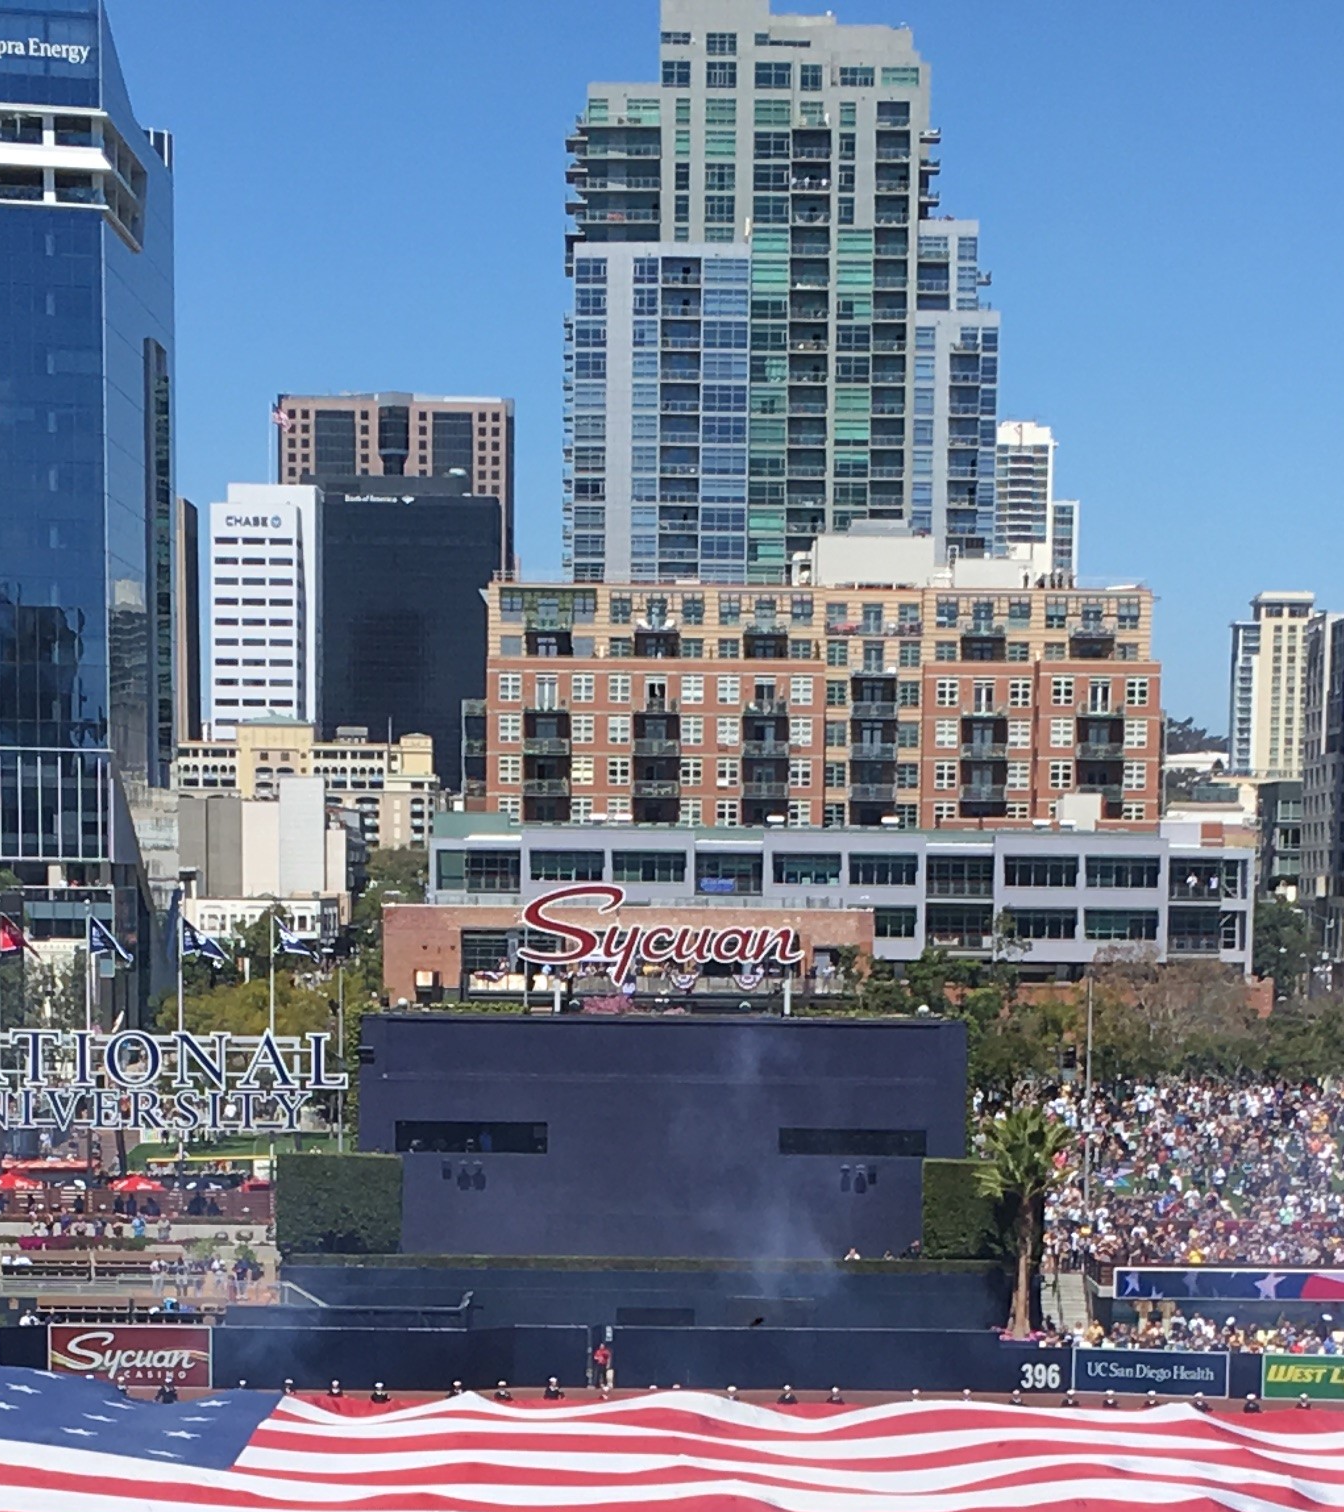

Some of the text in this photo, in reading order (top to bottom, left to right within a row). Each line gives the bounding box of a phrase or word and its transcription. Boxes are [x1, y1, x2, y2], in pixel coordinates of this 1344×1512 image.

[28, 37, 91, 65] Energy
[225, 515, 269, 528] CHASE
[517, 883, 806, 986] Sycuan
[66, 1331, 196, 1380] Sycuan
[123, 1370, 187, 1380] CASINO
[1019, 1363, 1061, 1389] 396
[1086, 1361, 1215, 1382] UC San Diego Health
[1266, 1364, 1327, 1384] WEST
